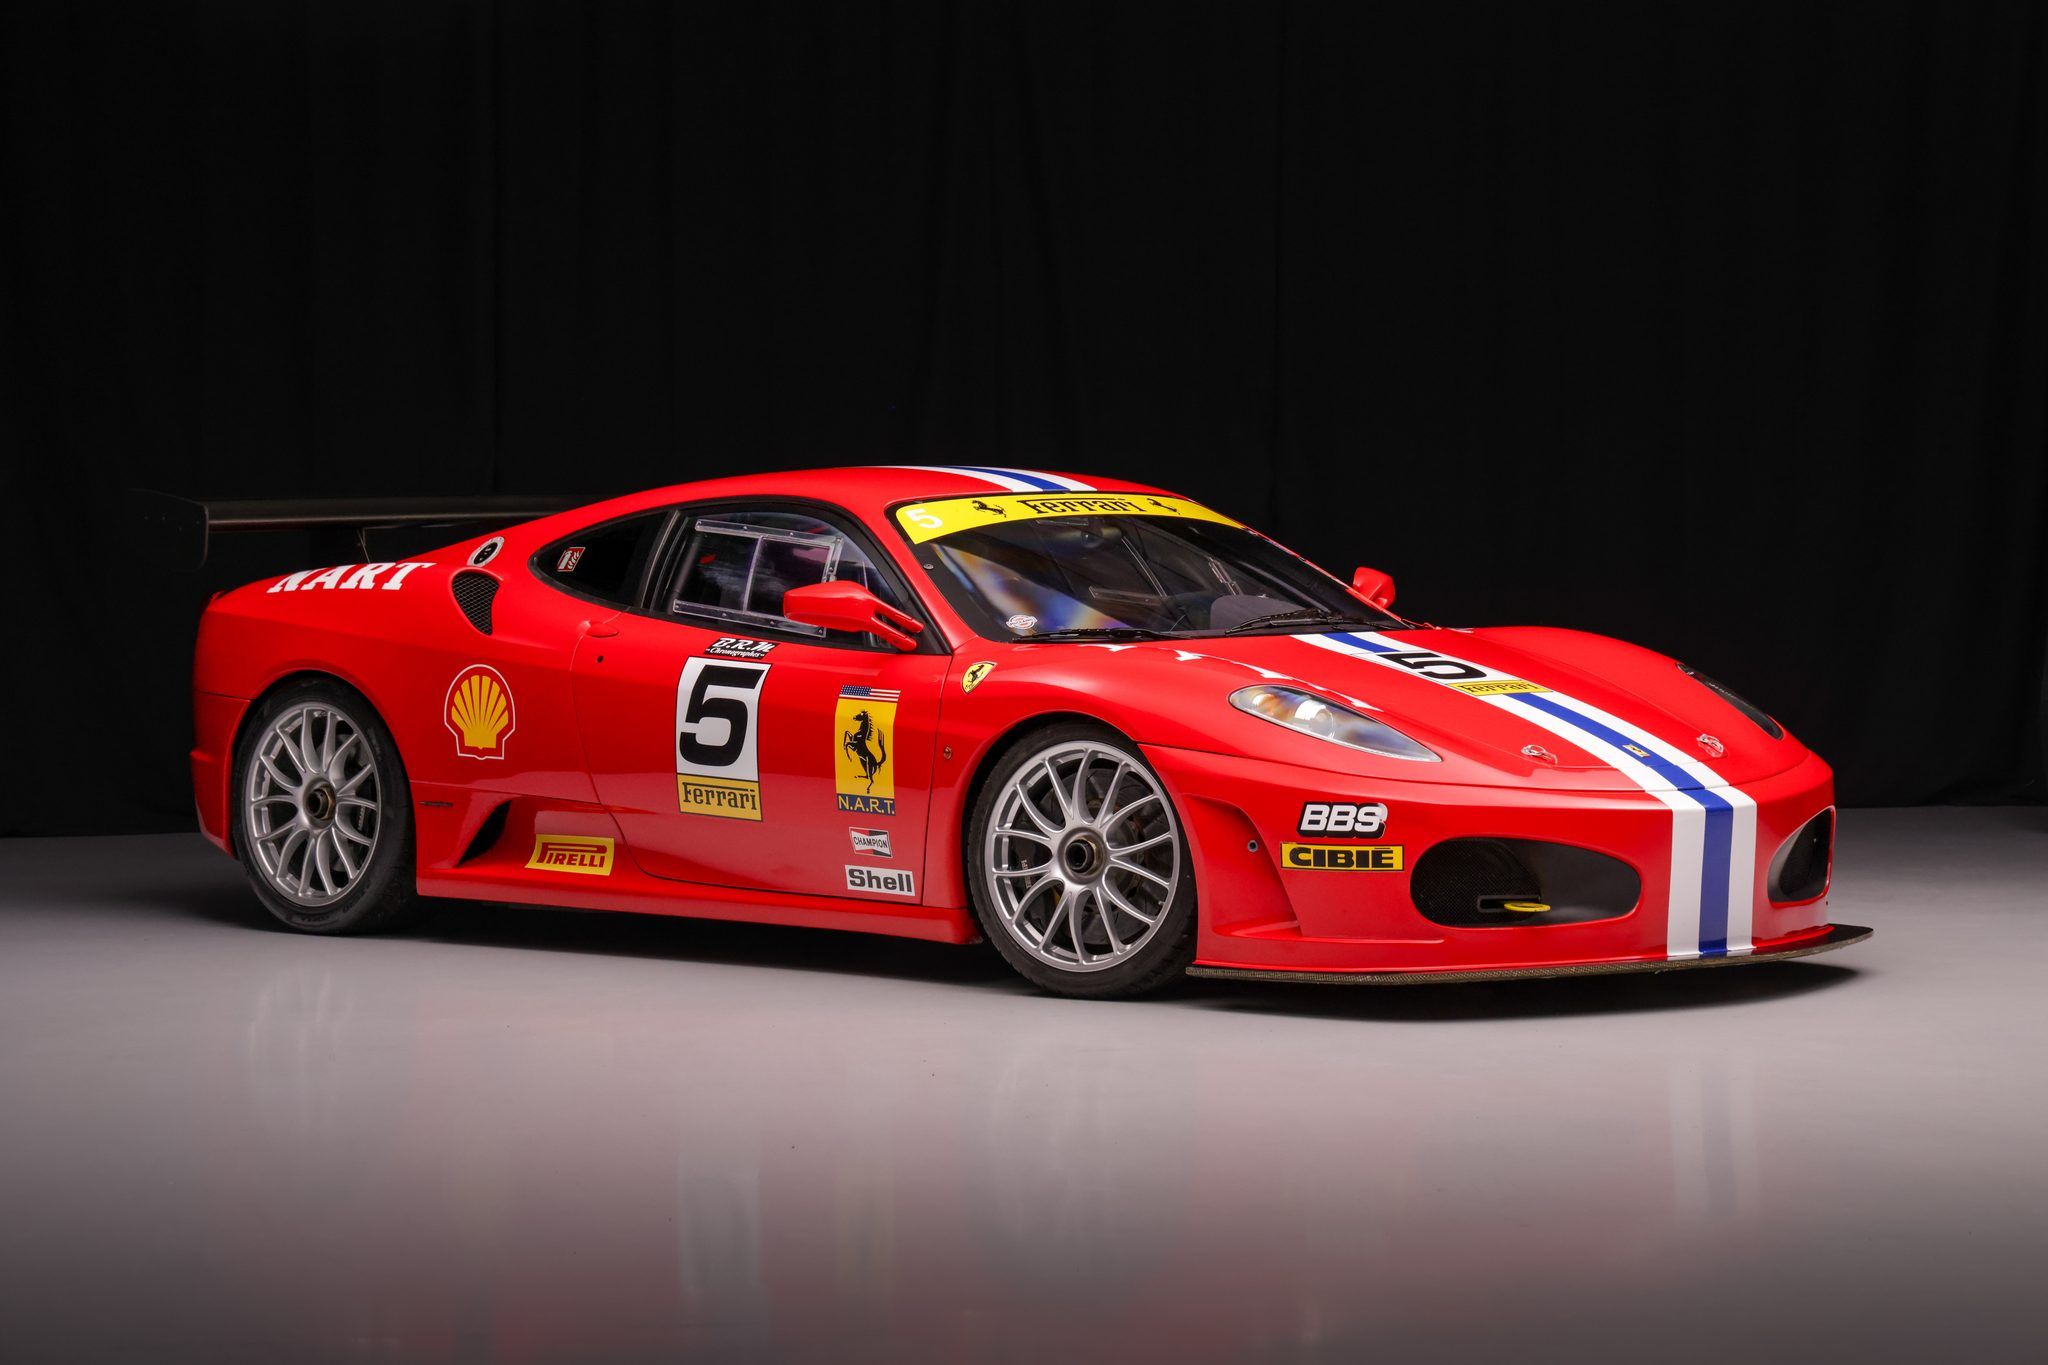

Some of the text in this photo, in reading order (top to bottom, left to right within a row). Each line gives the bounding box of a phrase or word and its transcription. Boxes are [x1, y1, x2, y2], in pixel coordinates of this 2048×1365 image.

[1016, 497, 1147, 514] Ferrari
[905, 508, 943, 529] 5
[266, 562, 437, 593] NART
[1377, 652, 1487, 680] 5
[1458, 681, 1540, 694] Ferrari
[680, 664, 765, 767] 5
[682, 782, 757, 810] Ferrari
[838, 795, 895, 815] N.A.R.T.
[1299, 803, 1384, 835] BBS
[536, 842, 607, 868] PIRELLI
[853, 836, 888, 849] CHAMPION
[849, 868, 912, 893] Shell
